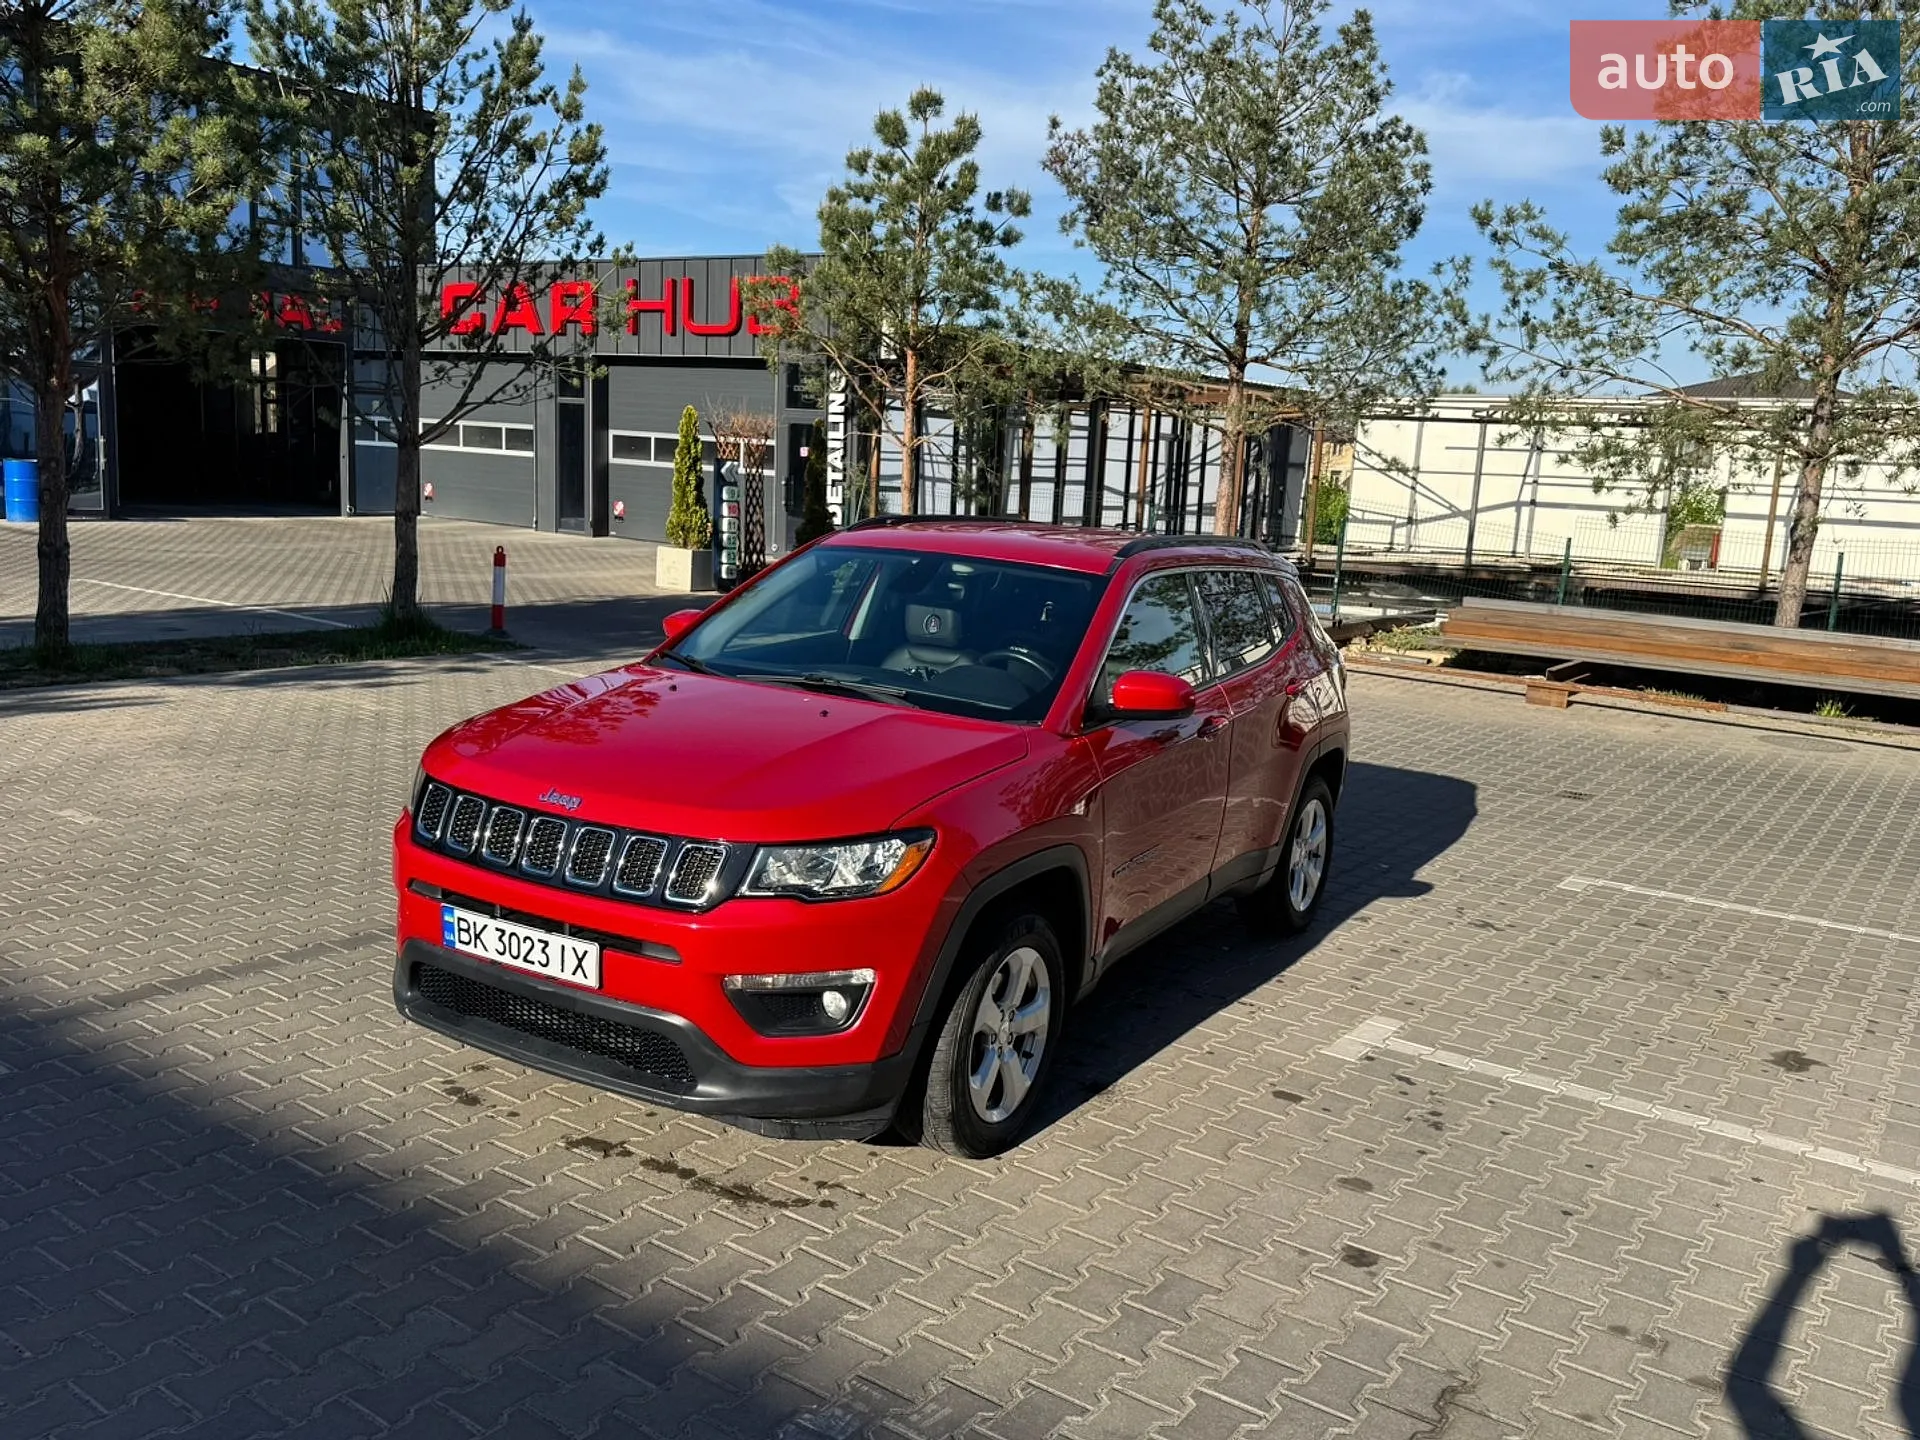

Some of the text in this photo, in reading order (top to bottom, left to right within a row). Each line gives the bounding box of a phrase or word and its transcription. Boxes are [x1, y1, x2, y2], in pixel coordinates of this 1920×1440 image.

[441, 279, 598, 336] CAR
[538, 787, 582, 811] Jeep
[457, 916, 589, 980] BK 3023 IX
